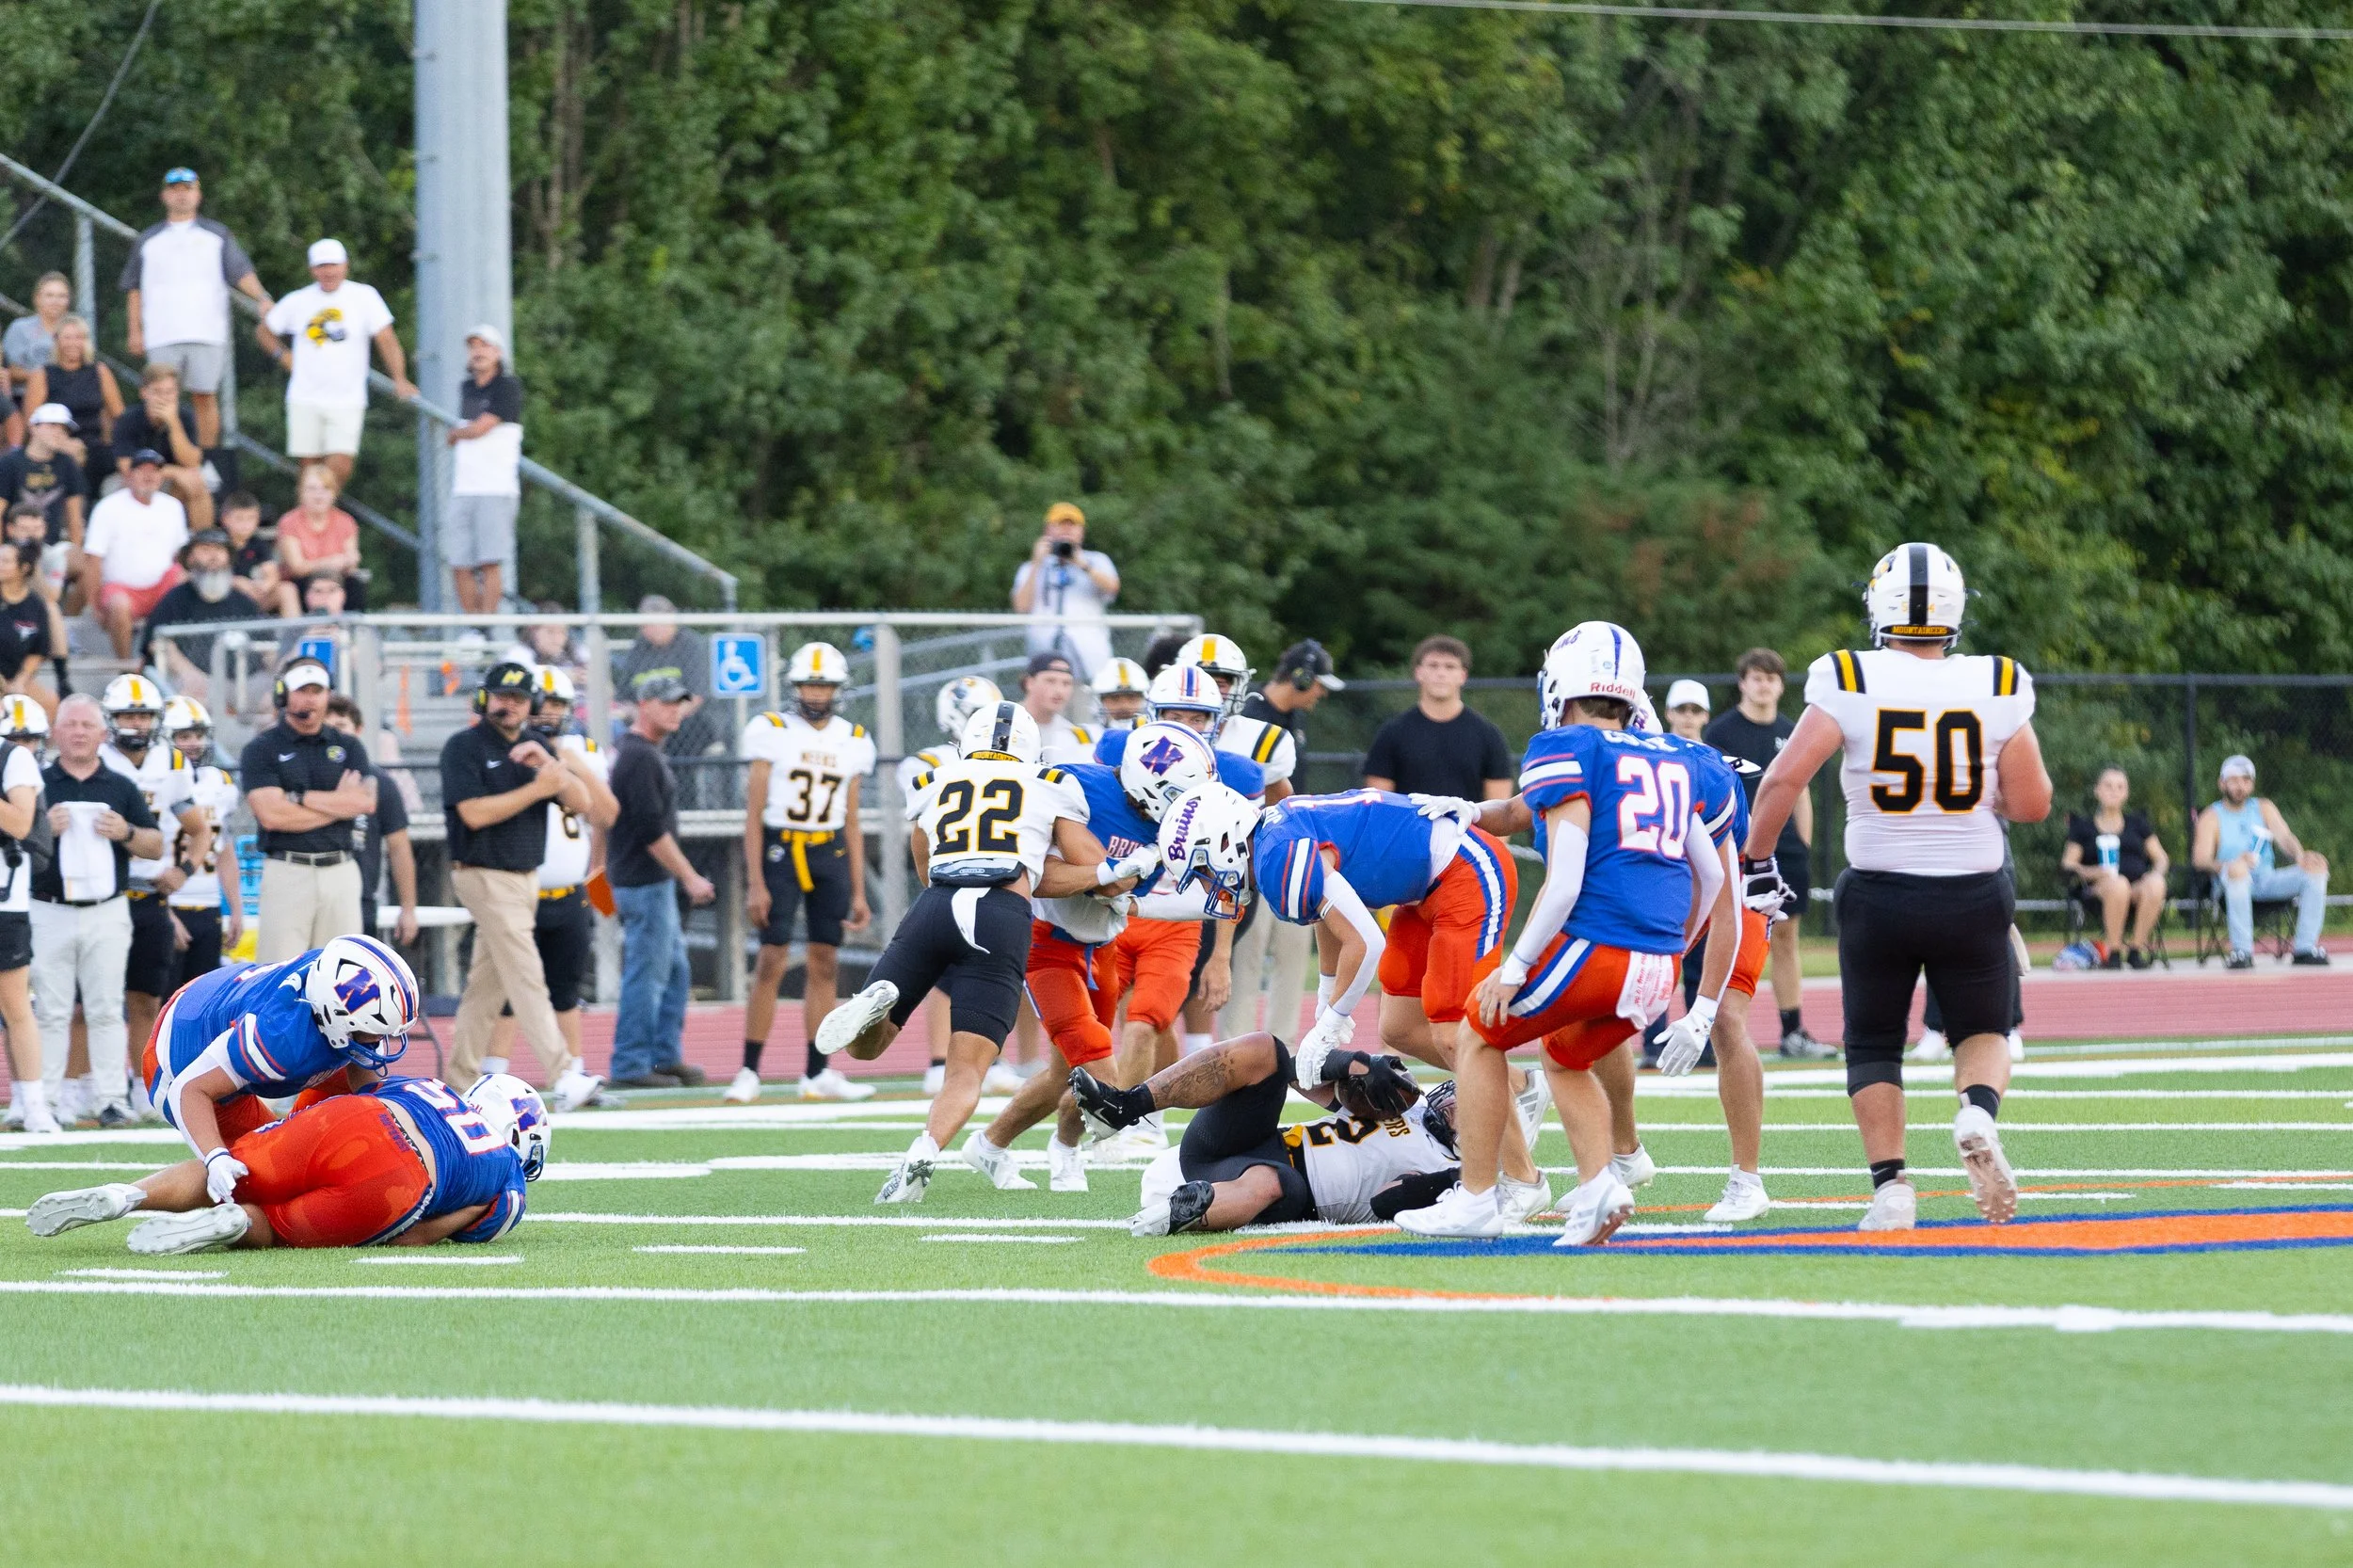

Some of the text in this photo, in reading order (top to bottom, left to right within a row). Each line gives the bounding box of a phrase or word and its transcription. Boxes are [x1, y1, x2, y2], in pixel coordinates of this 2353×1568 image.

[1589, 680, 1636, 699] Riddell
[1868, 707, 1984, 814] 50
[786, 767, 844, 824] 37
[930, 778, 1025, 857] 22
[1615, 754, 1690, 859] 20
[1167, 799, 1199, 861] Bruins
[333, 967, 381, 1015] N
